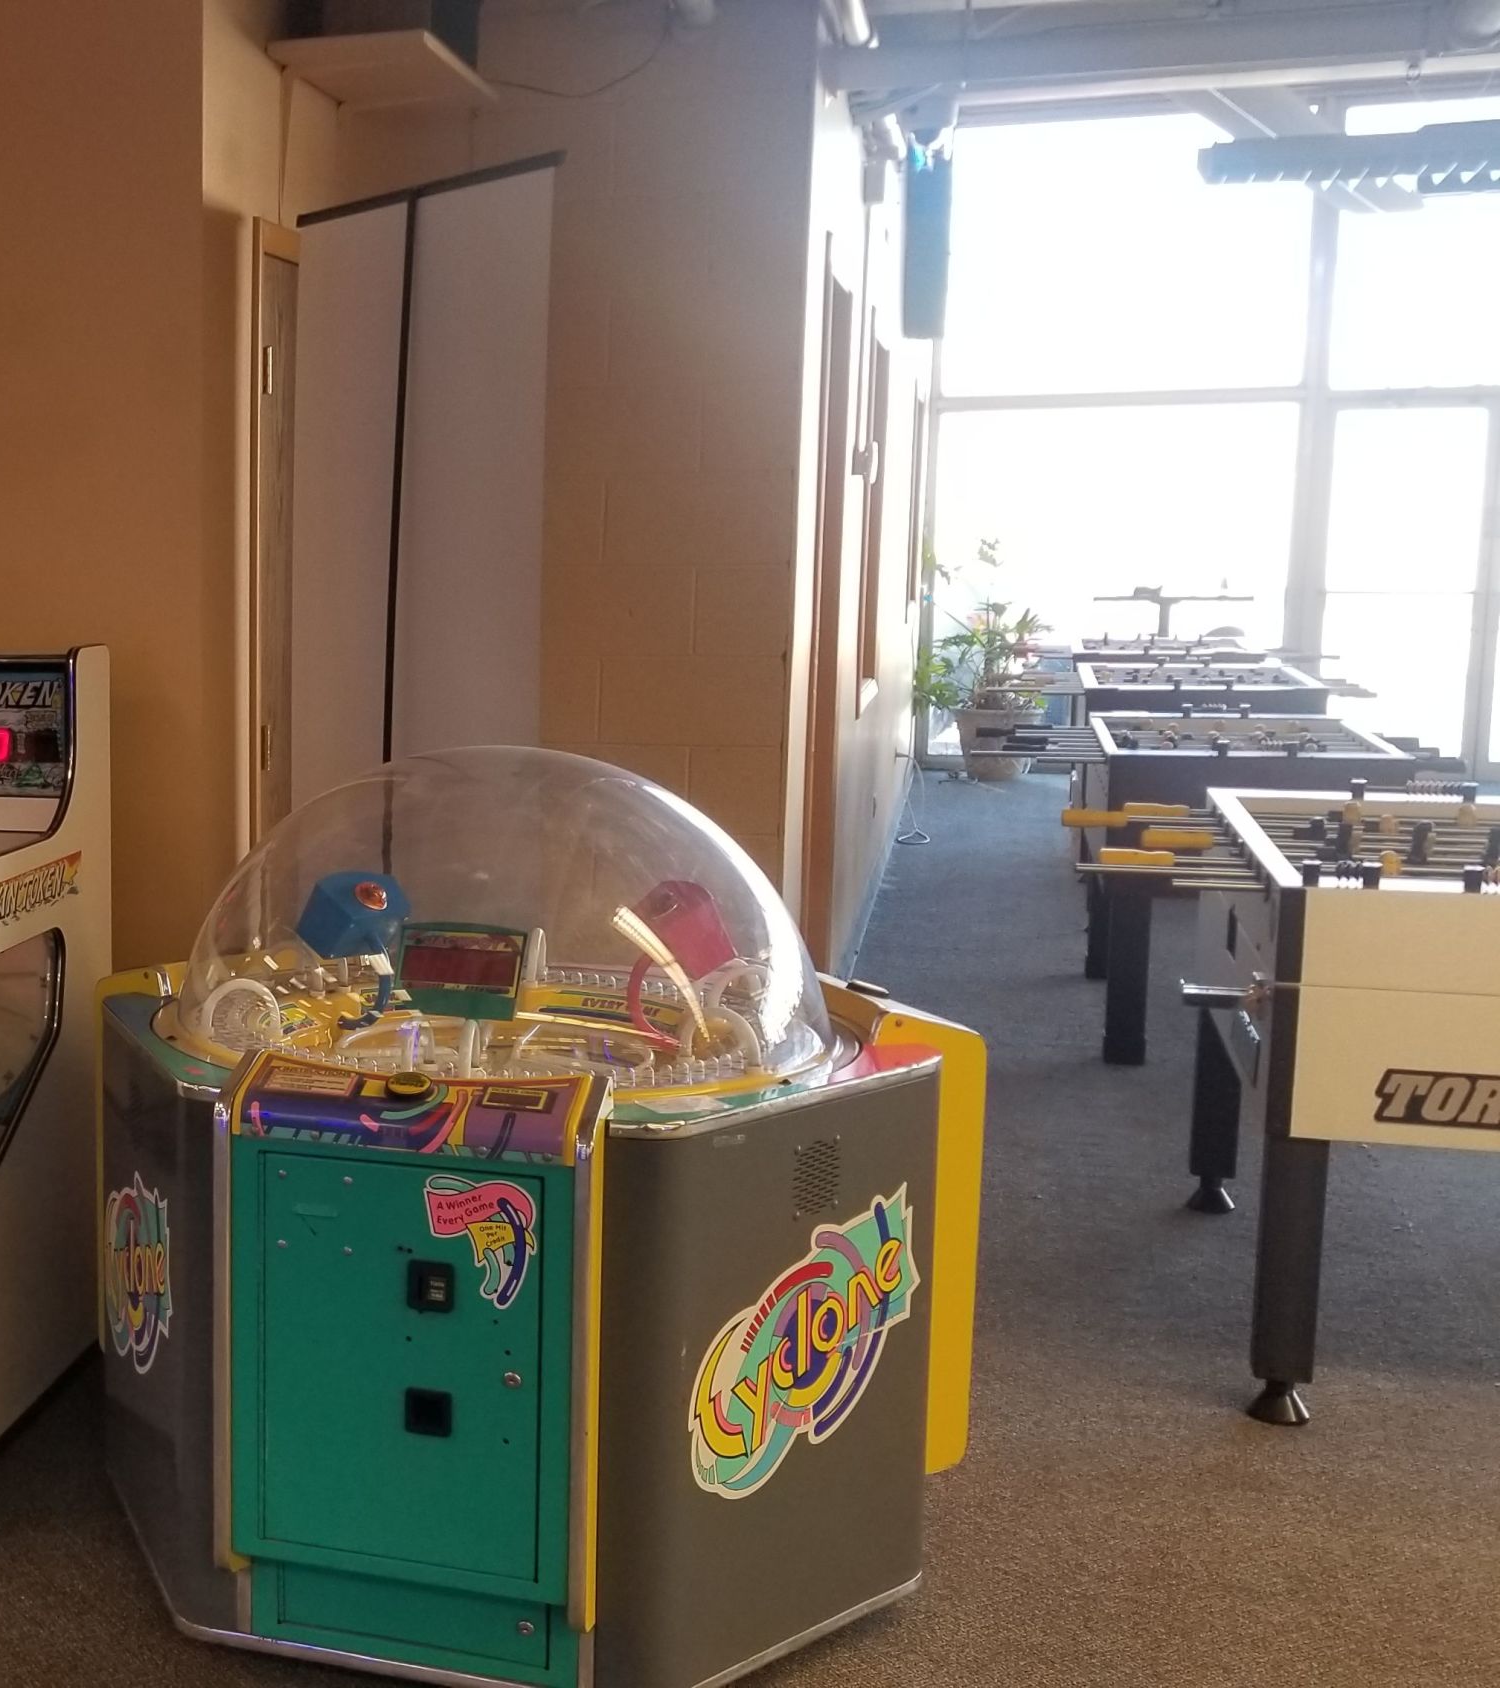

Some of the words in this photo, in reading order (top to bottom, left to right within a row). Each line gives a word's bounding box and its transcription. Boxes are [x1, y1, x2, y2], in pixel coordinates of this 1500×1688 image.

[1381, 1073, 1500, 1125] TOR
[436, 1201, 444, 1210] A
[446, 1194, 482, 1211] Winner
[437, 1215, 464, 1225] Every
[464, 1200, 495, 1218] Game
[693, 1237, 903, 1459] Cyclone
